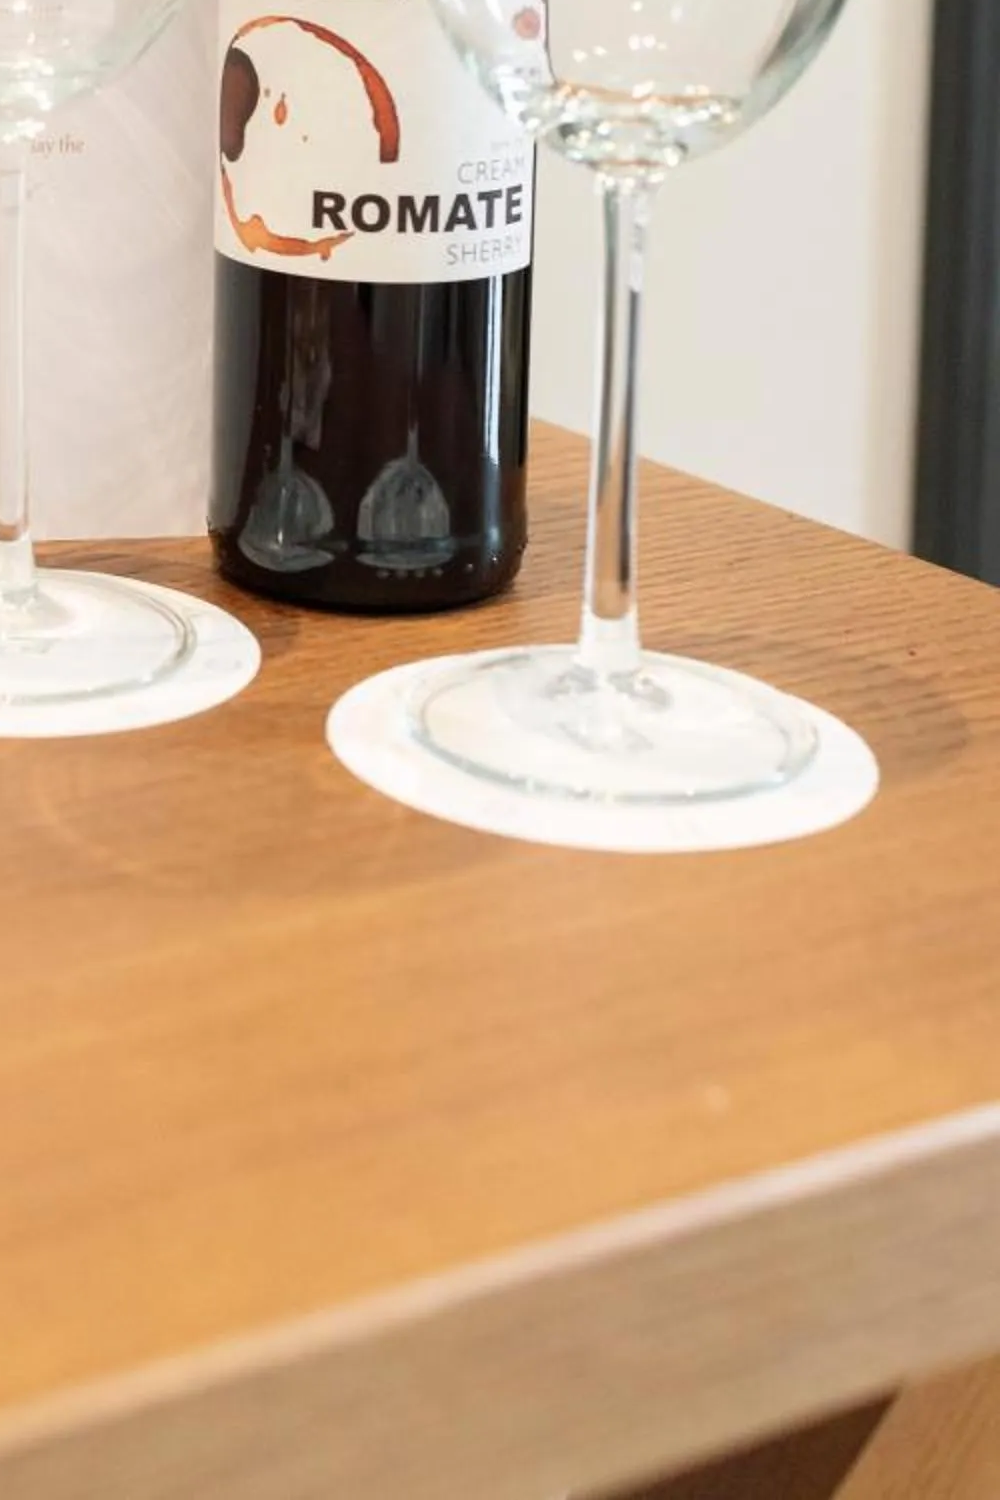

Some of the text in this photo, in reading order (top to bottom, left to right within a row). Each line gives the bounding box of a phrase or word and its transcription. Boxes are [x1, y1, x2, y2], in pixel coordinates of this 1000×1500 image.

[58, 133, 85, 154] the
[457, 156, 526, 184] CREAM
[311, 183, 523, 234] ROMATE
